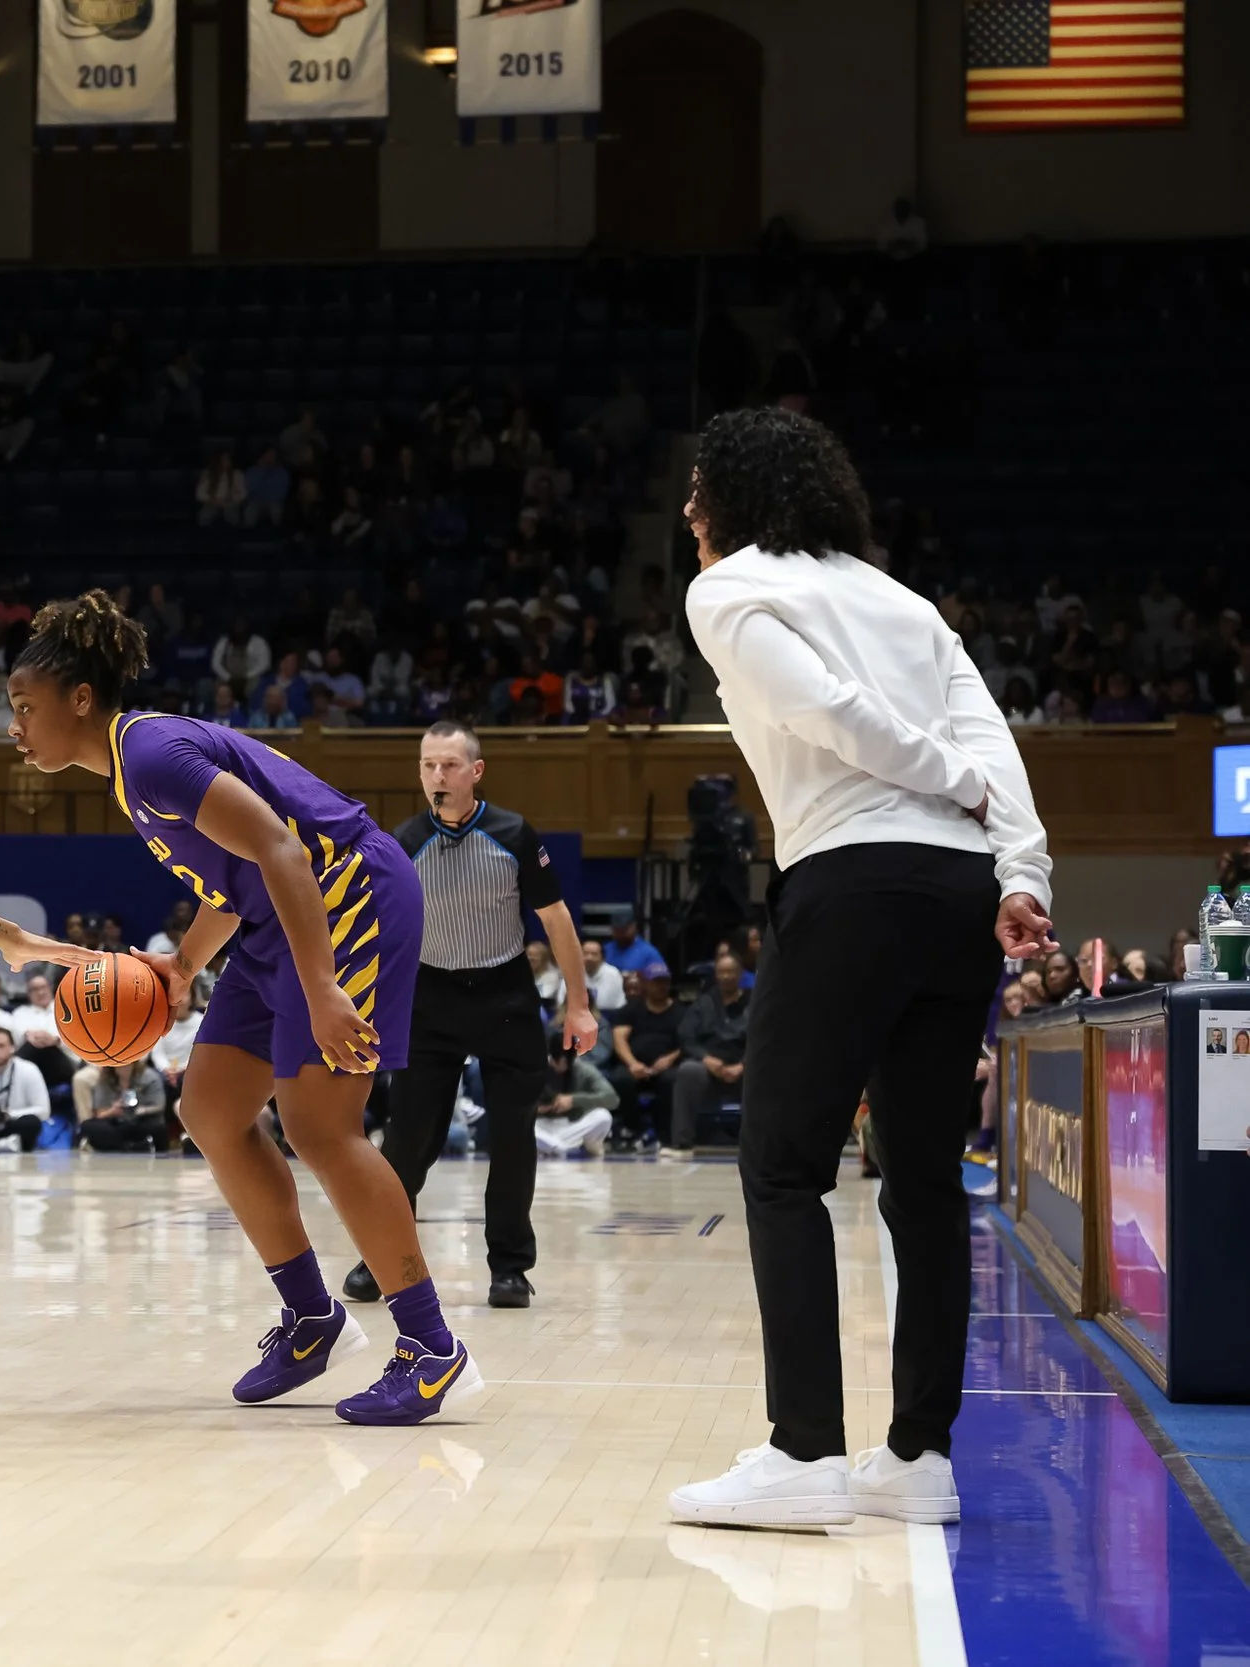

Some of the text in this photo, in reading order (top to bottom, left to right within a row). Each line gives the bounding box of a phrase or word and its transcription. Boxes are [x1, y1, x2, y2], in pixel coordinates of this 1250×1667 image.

[78, 64, 137, 89] 2001
[289, 57, 351, 83] 2010
[499, 51, 563, 77] 2015
